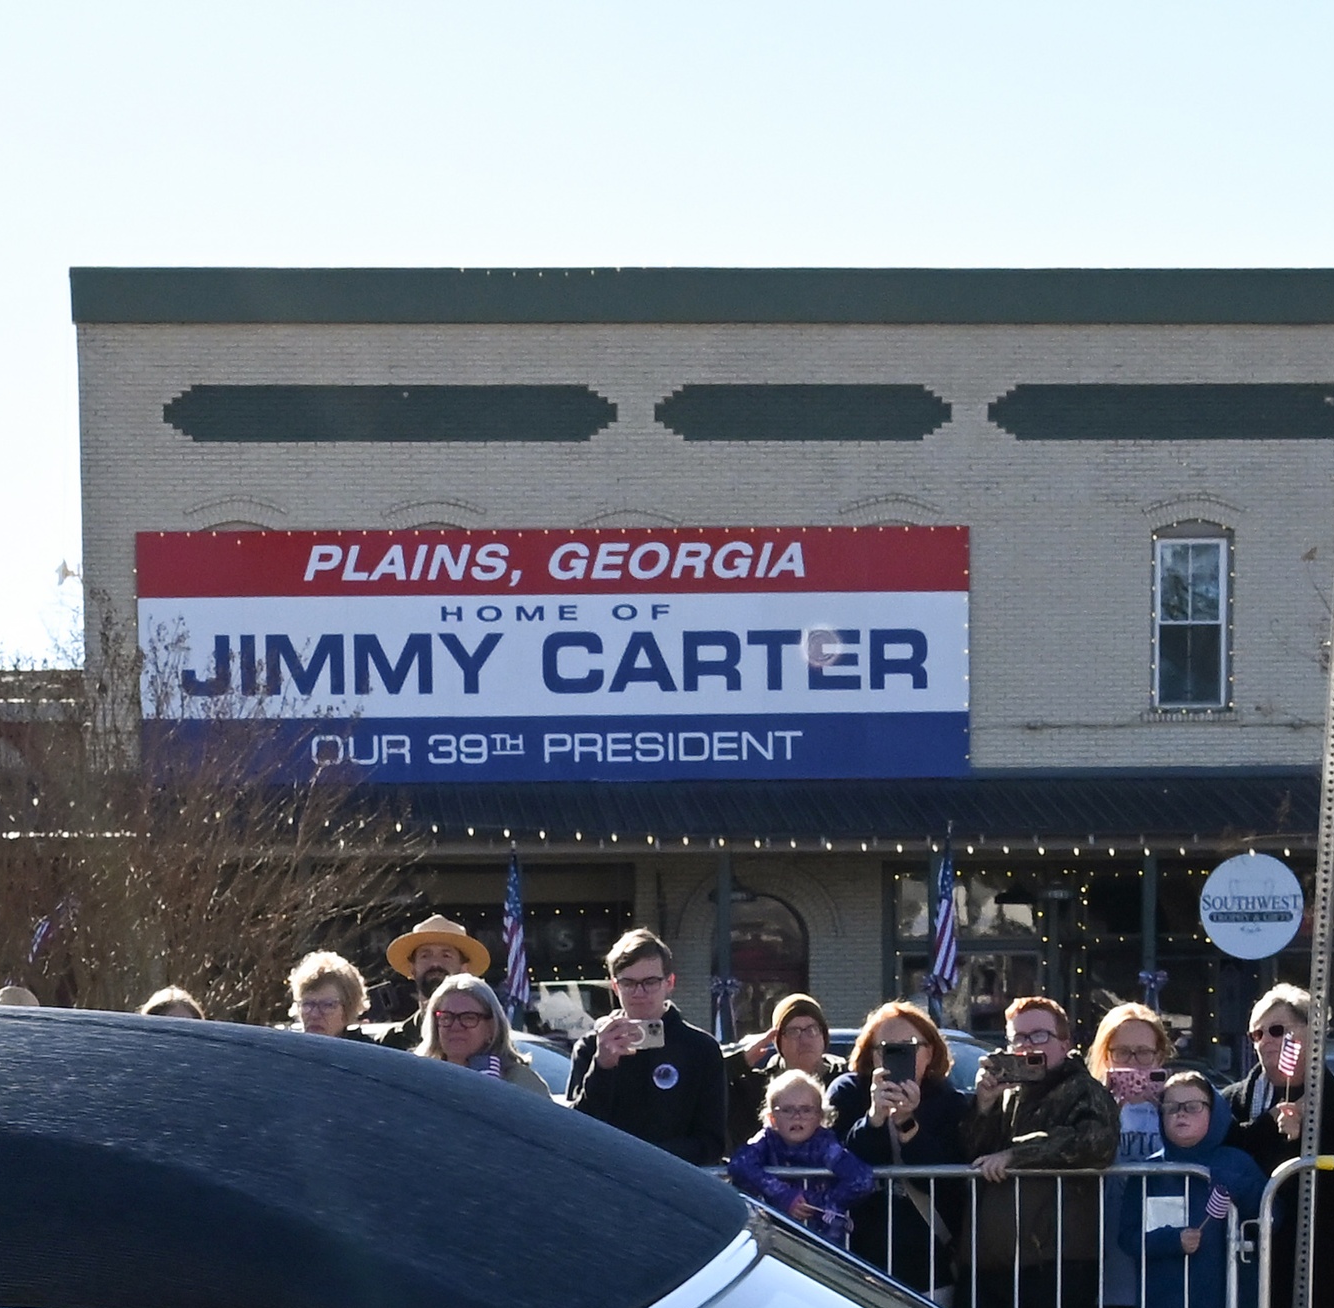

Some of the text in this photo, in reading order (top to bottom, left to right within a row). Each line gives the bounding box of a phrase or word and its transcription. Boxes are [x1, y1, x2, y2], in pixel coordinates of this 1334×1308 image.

[303, 541, 806, 587] PLAINS, GEORGIA
[440, 603, 671, 623] HOME OF
[181, 628, 928, 697] JIMMY CARTER
[310, 734, 412, 766] OUR
[543, 730, 804, 764] PRESIDENT
[1202, 893, 1301, 911] SOUTHWEST
